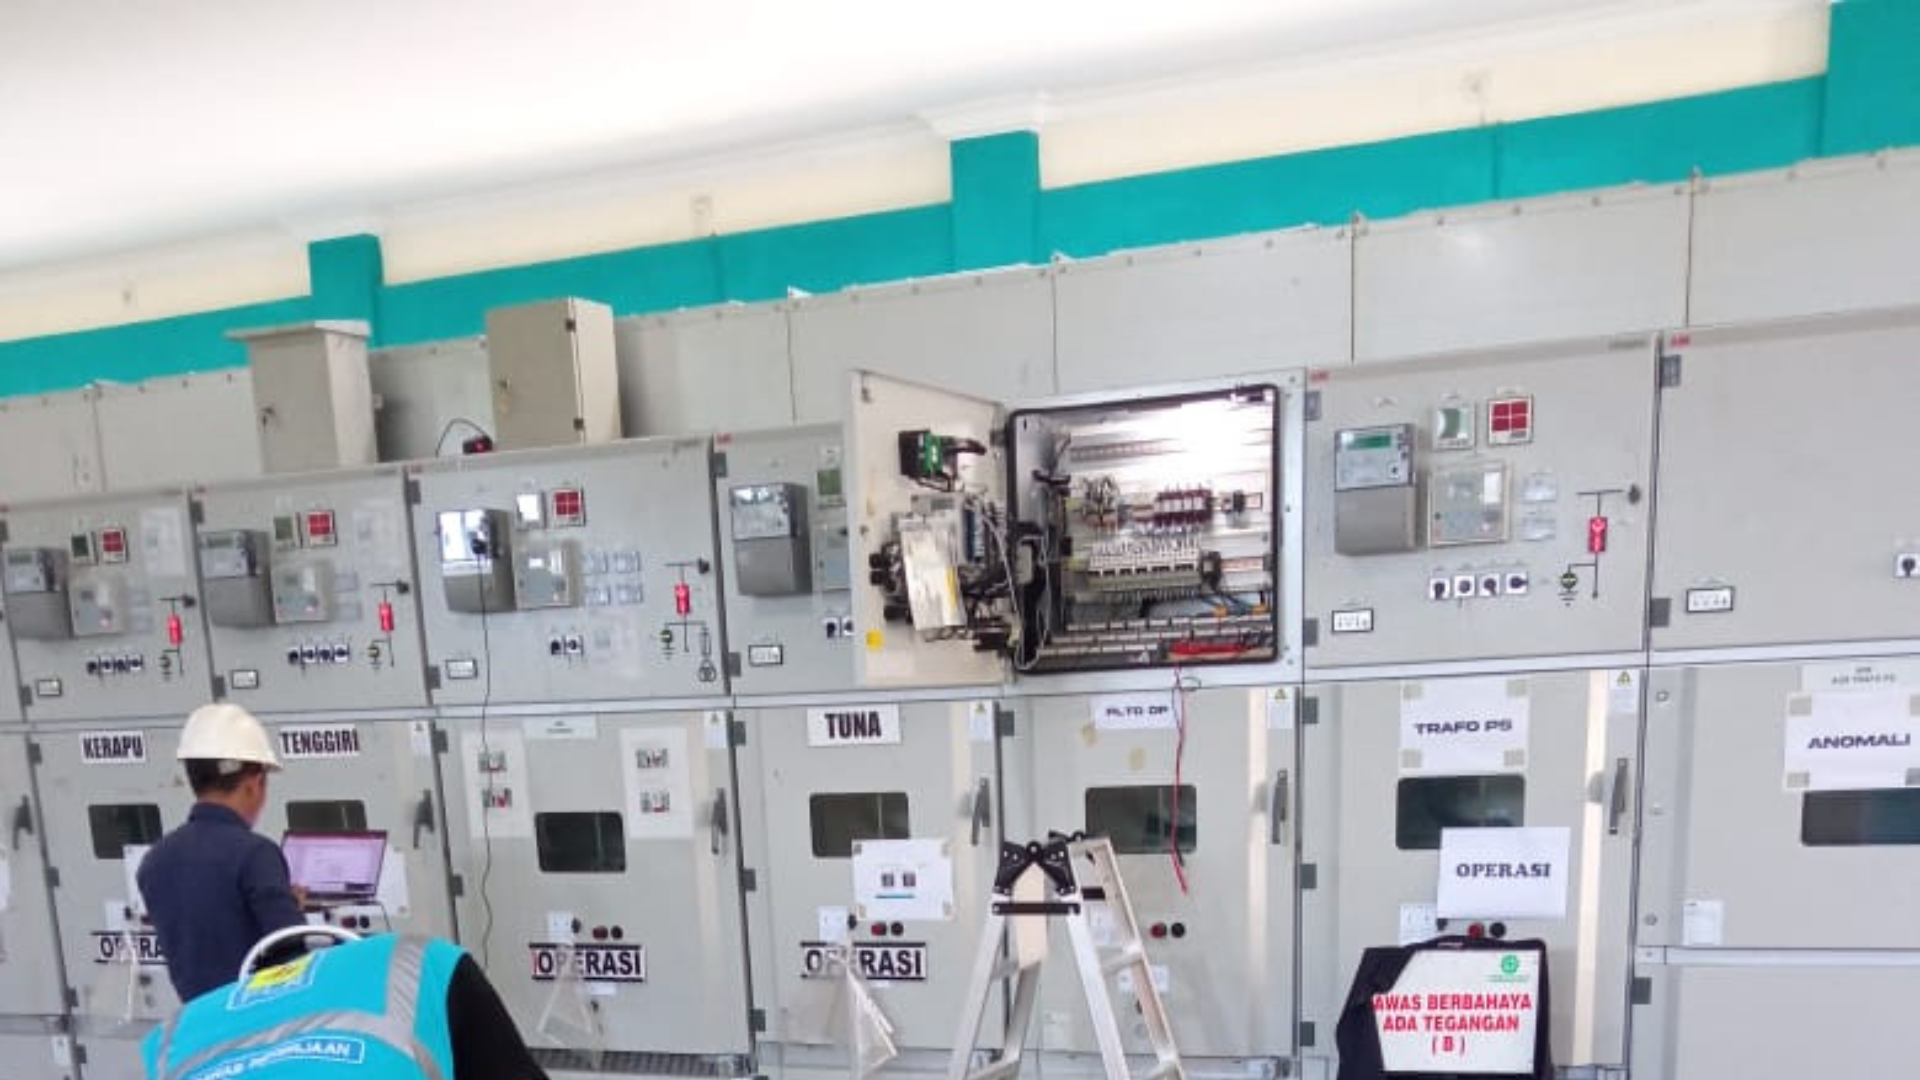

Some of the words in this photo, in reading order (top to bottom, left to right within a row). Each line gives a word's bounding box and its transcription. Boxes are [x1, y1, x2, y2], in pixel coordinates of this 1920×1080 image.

[824, 711, 882, 738] TUNA
[1414, 720, 1480, 734] TRAFO
[83, 736, 144, 758] KERAPU
[281, 730, 359, 754] TENGGIRI
[1807, 733, 1911, 749] ANOMALI
[1456, 863, 1551, 878] OPERASI
[806, 949, 922, 975] ORASI
[1373, 994, 1421, 1010] AWAS
[1427, 994, 1532, 1010] BERBAHAYA
[1383, 1016, 1417, 1031] ADA
[1423, 1016, 1519, 1031] TEGANGAN
